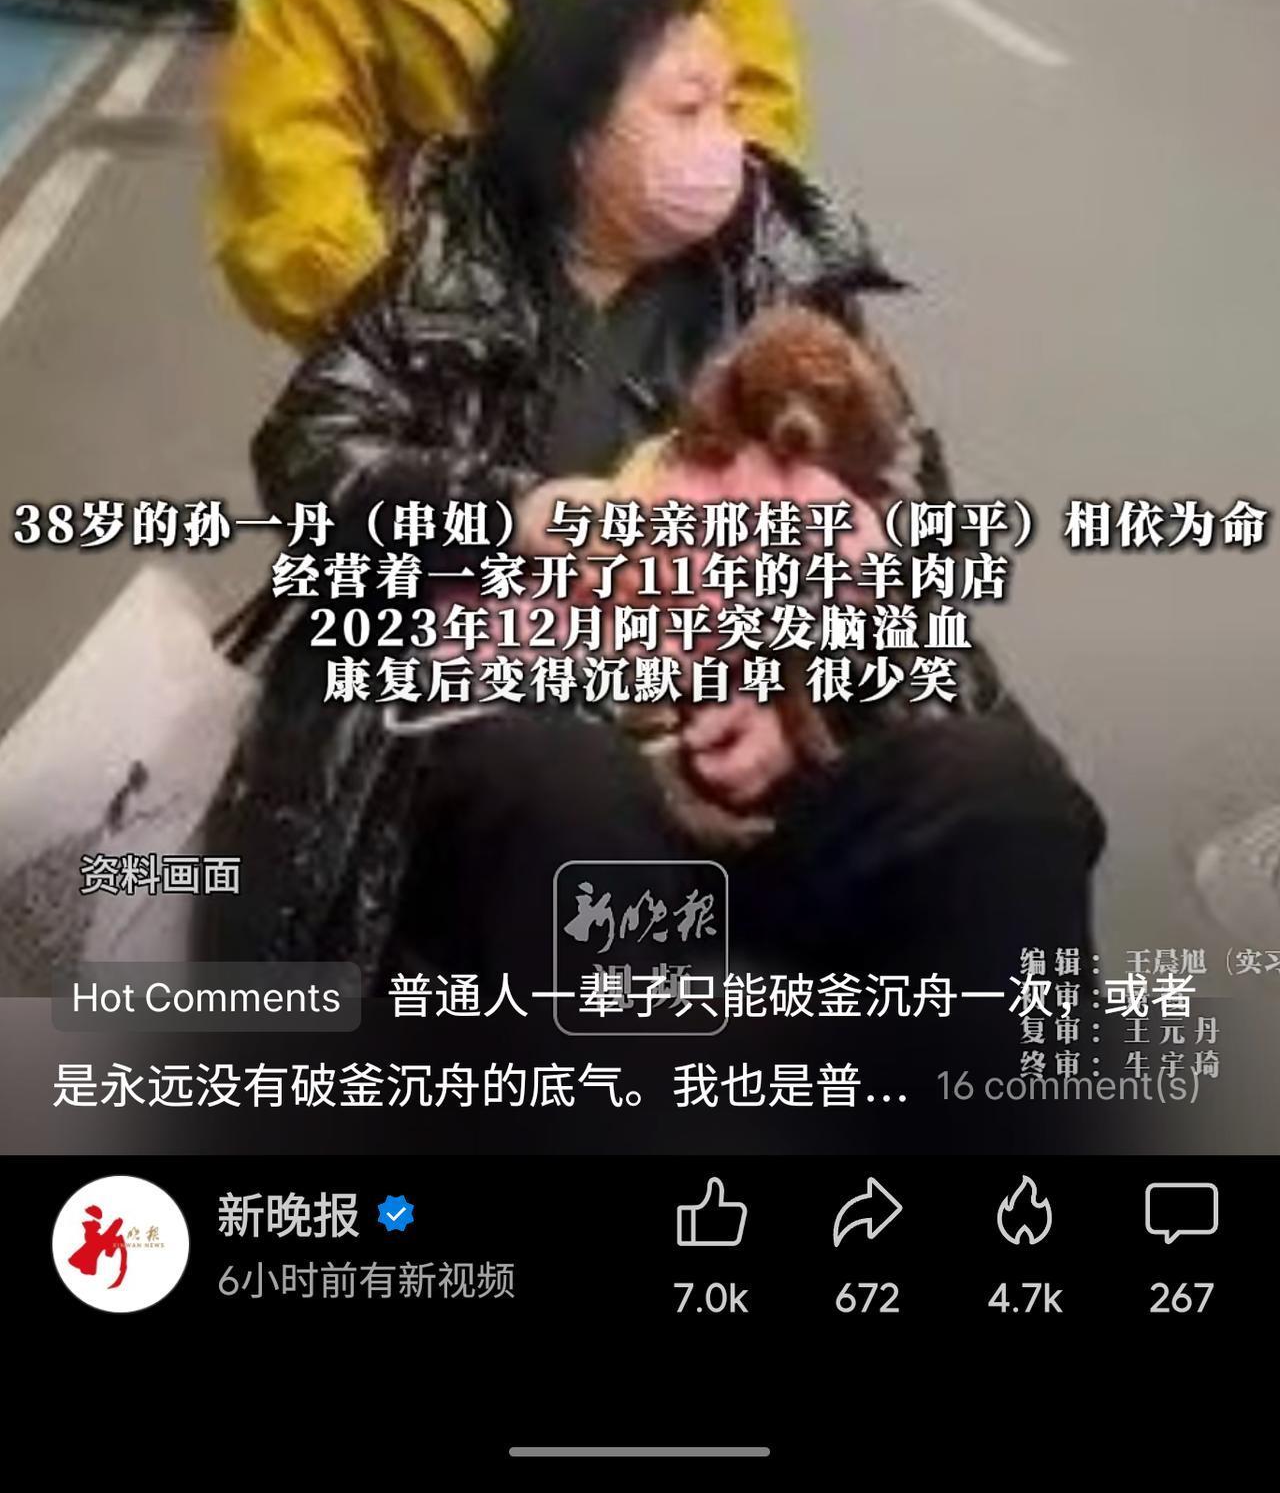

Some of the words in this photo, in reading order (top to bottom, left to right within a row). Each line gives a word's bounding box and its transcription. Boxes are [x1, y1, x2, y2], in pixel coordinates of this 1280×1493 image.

[72, 982, 136, 1013] Hot
[145, 982, 341, 1013] Comments
[388, 972, 1196, 1019] 普通人一辈子只能破釜沉舟一次，或者
[938, 1070, 974, 1101] 16
[985, 1065, 1200, 1103] comment(s)
[218, 1193, 360, 1239] 新晚报
[218, 1261, 515, 1301] 6小时前有新视频
[674, 1281, 748, 1313] 7.0k
[988, 1281, 1063, 1313] 4.7k
[835, 1282, 900, 1313] 672
[1149, 1282, 1215, 1313] 267
